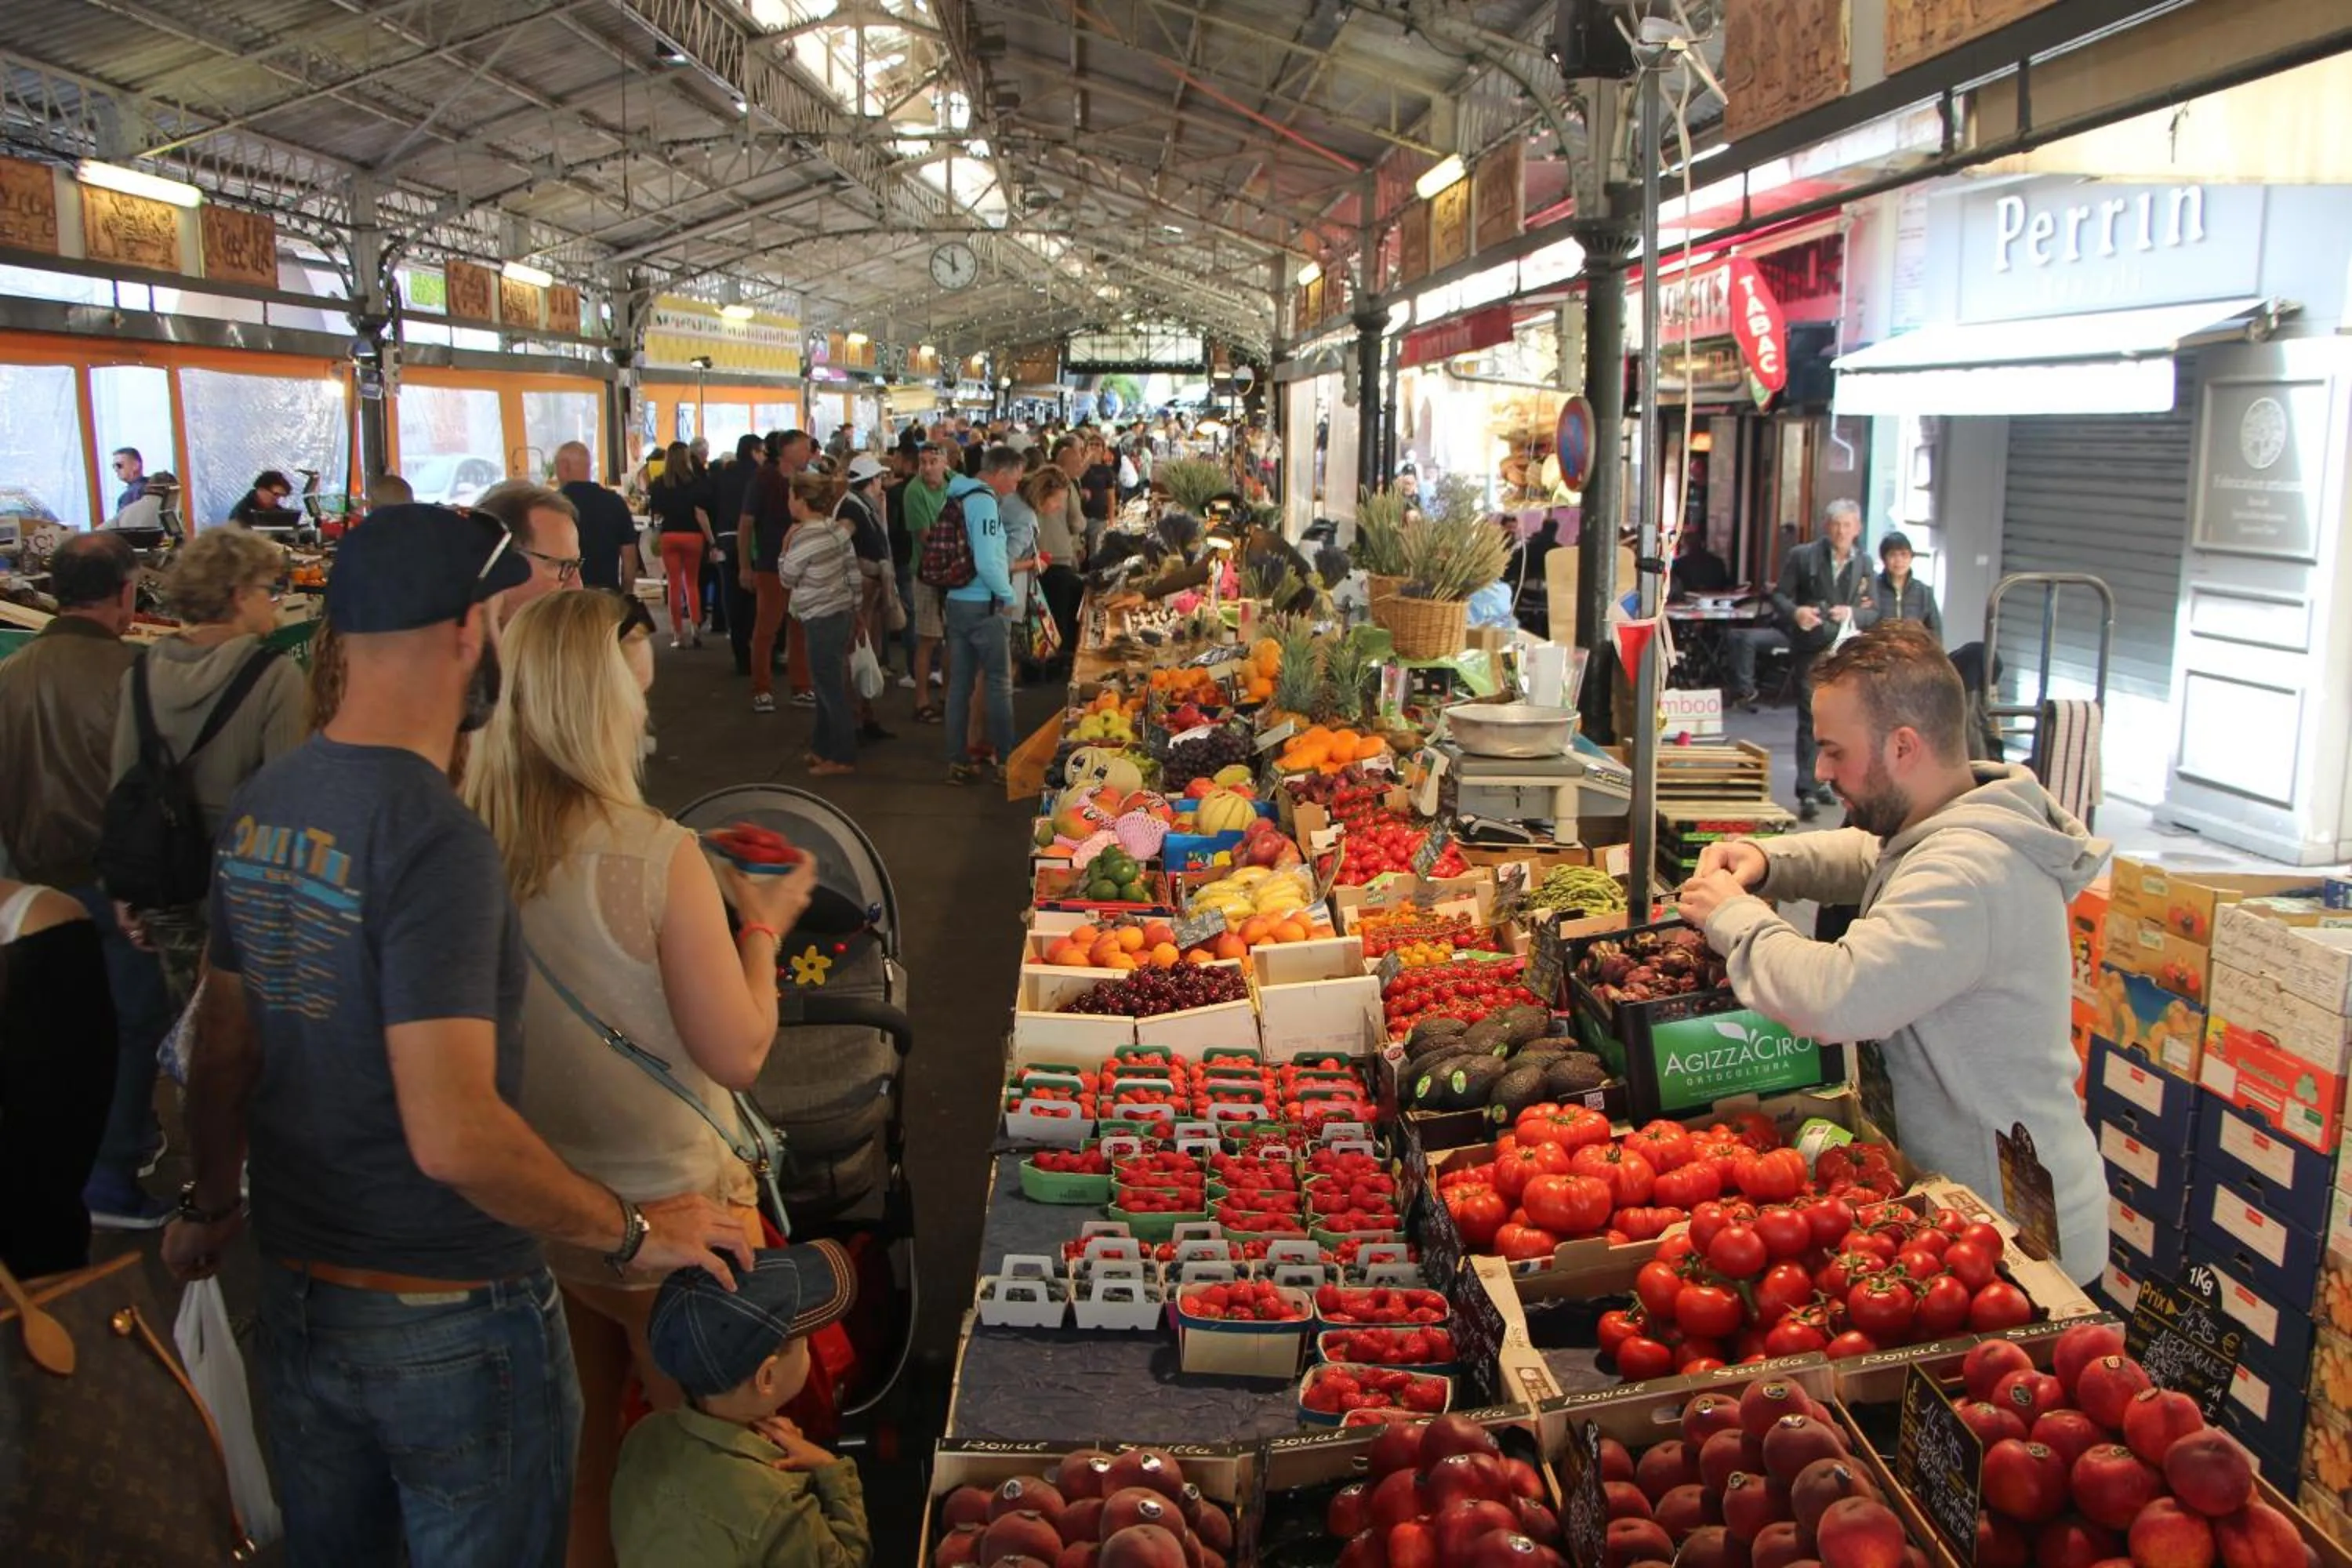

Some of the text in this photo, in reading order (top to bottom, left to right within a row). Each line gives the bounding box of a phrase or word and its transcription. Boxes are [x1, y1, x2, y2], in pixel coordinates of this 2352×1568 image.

[1992, 184, 2207, 274] Perrin
[1737, 275, 1780, 374] TABAC
[1686, 1059, 1791, 1087] ORTOCOLTURA
[2140, 1279, 2167, 1315] Prix
[1860, 1343, 1941, 1366] Royal
[1563, 1356, 1810, 1406] Royal Sevilla
[961, 1441, 1048, 1452] Royal
